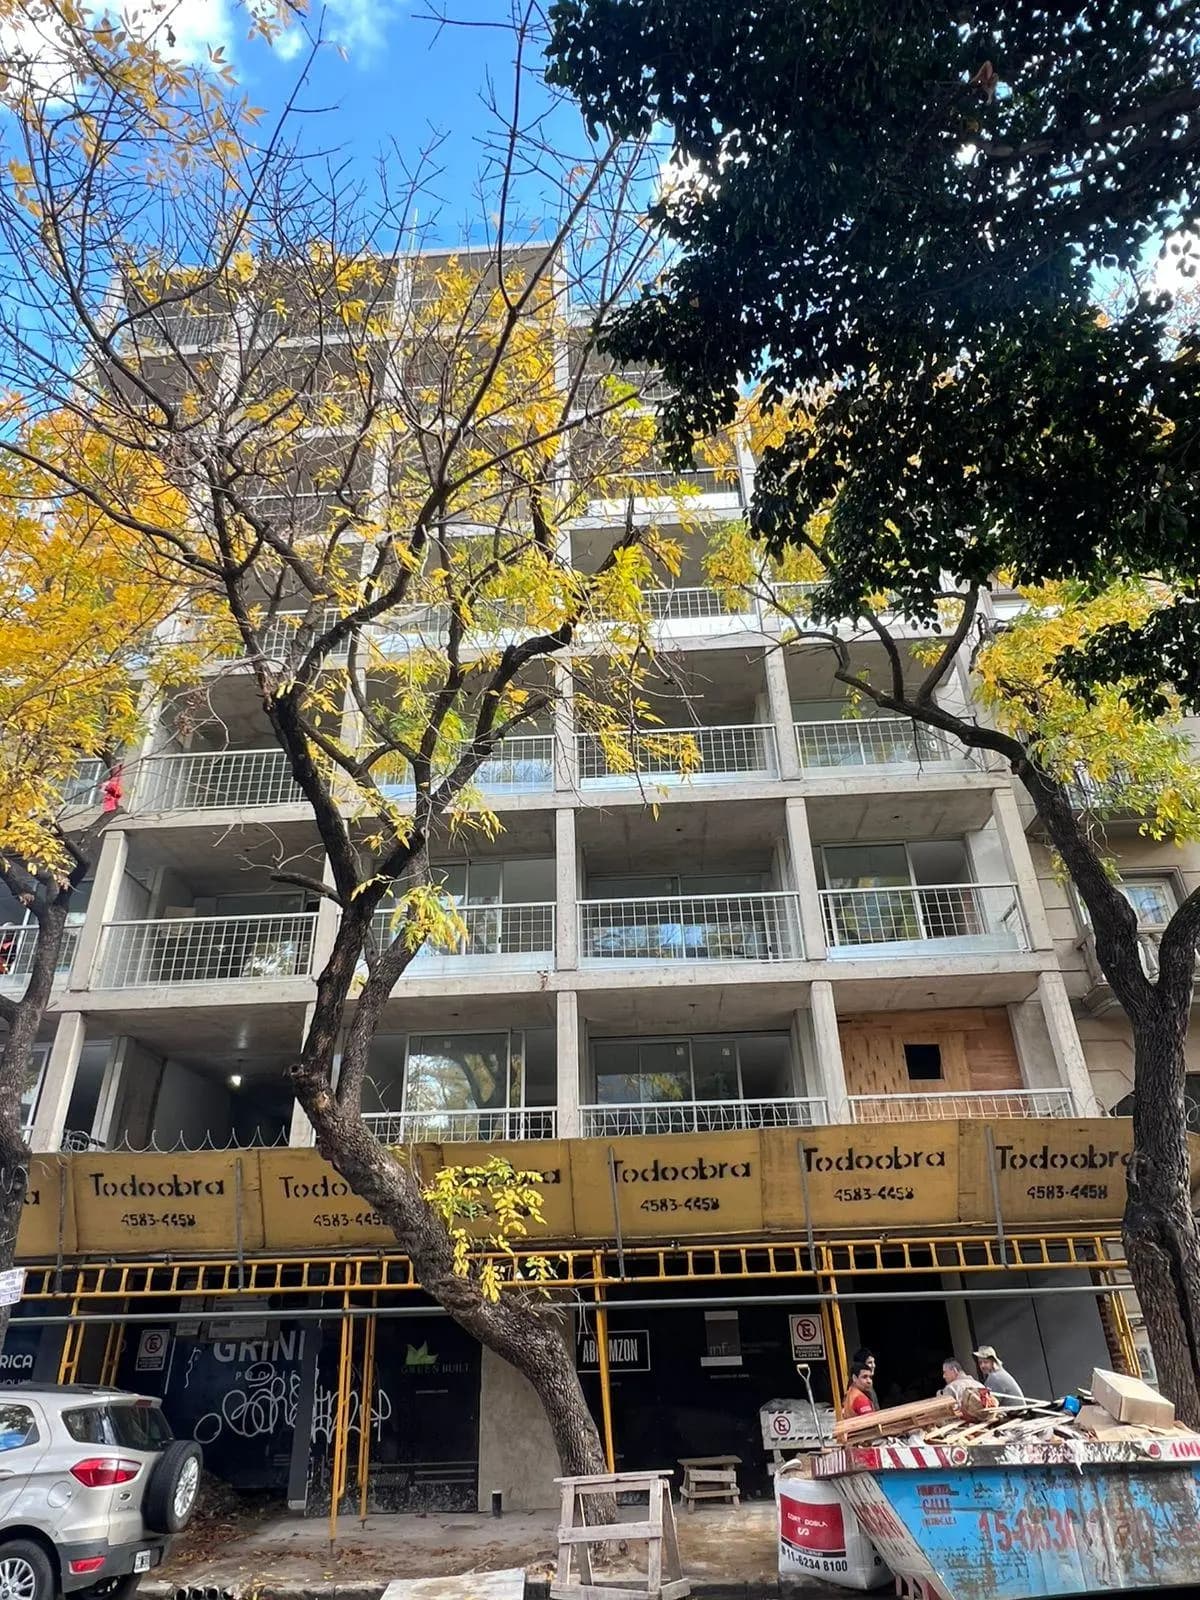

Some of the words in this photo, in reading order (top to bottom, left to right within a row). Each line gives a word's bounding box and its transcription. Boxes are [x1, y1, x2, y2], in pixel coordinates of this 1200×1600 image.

[803, 1146, 946, 1172] Todoobra
[608, 1157, 751, 1183] Todoobra
[89, 1173, 225, 1197] Todoobra
[279, 1175, 358, 1198] Todo
[1027, 1184, 1108, 1200] 4583-4458
[834, 1186, 915, 1201] 4583-4458
[640, 1197, 720, 1212] 4583-4458
[121, 1213, 197, 1227] 4583-4458
[313, 1213, 388, 1228] 4583-445
[582, 1338, 638, 1363] ABMZON
[823, 1560, 848, 1572] 8100
